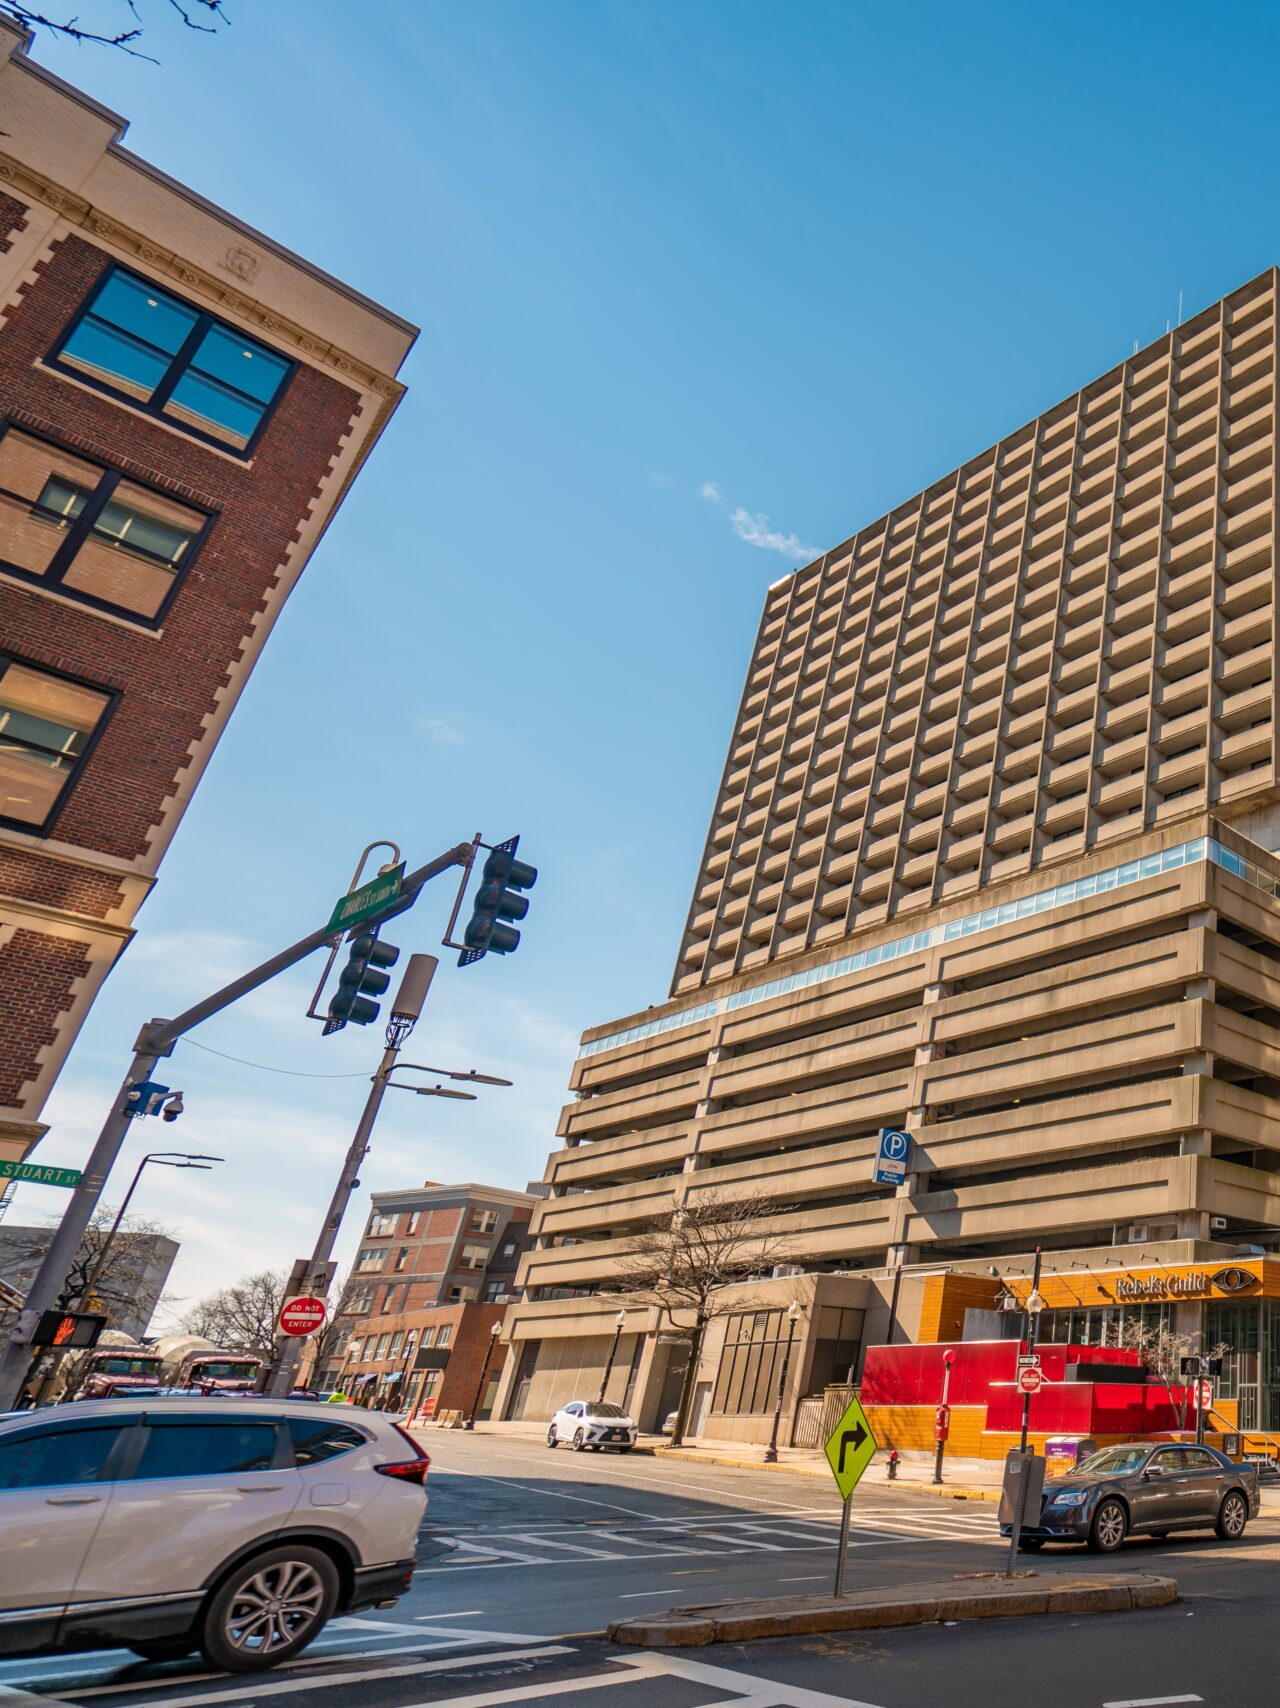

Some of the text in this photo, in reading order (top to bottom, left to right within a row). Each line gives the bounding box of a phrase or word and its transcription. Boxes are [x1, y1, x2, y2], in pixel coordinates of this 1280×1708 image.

[890, 1135, 903, 1155] P
[3, 1164, 65, 1182] STUART
[1115, 1271, 1207, 1296] Rebel's Guild
